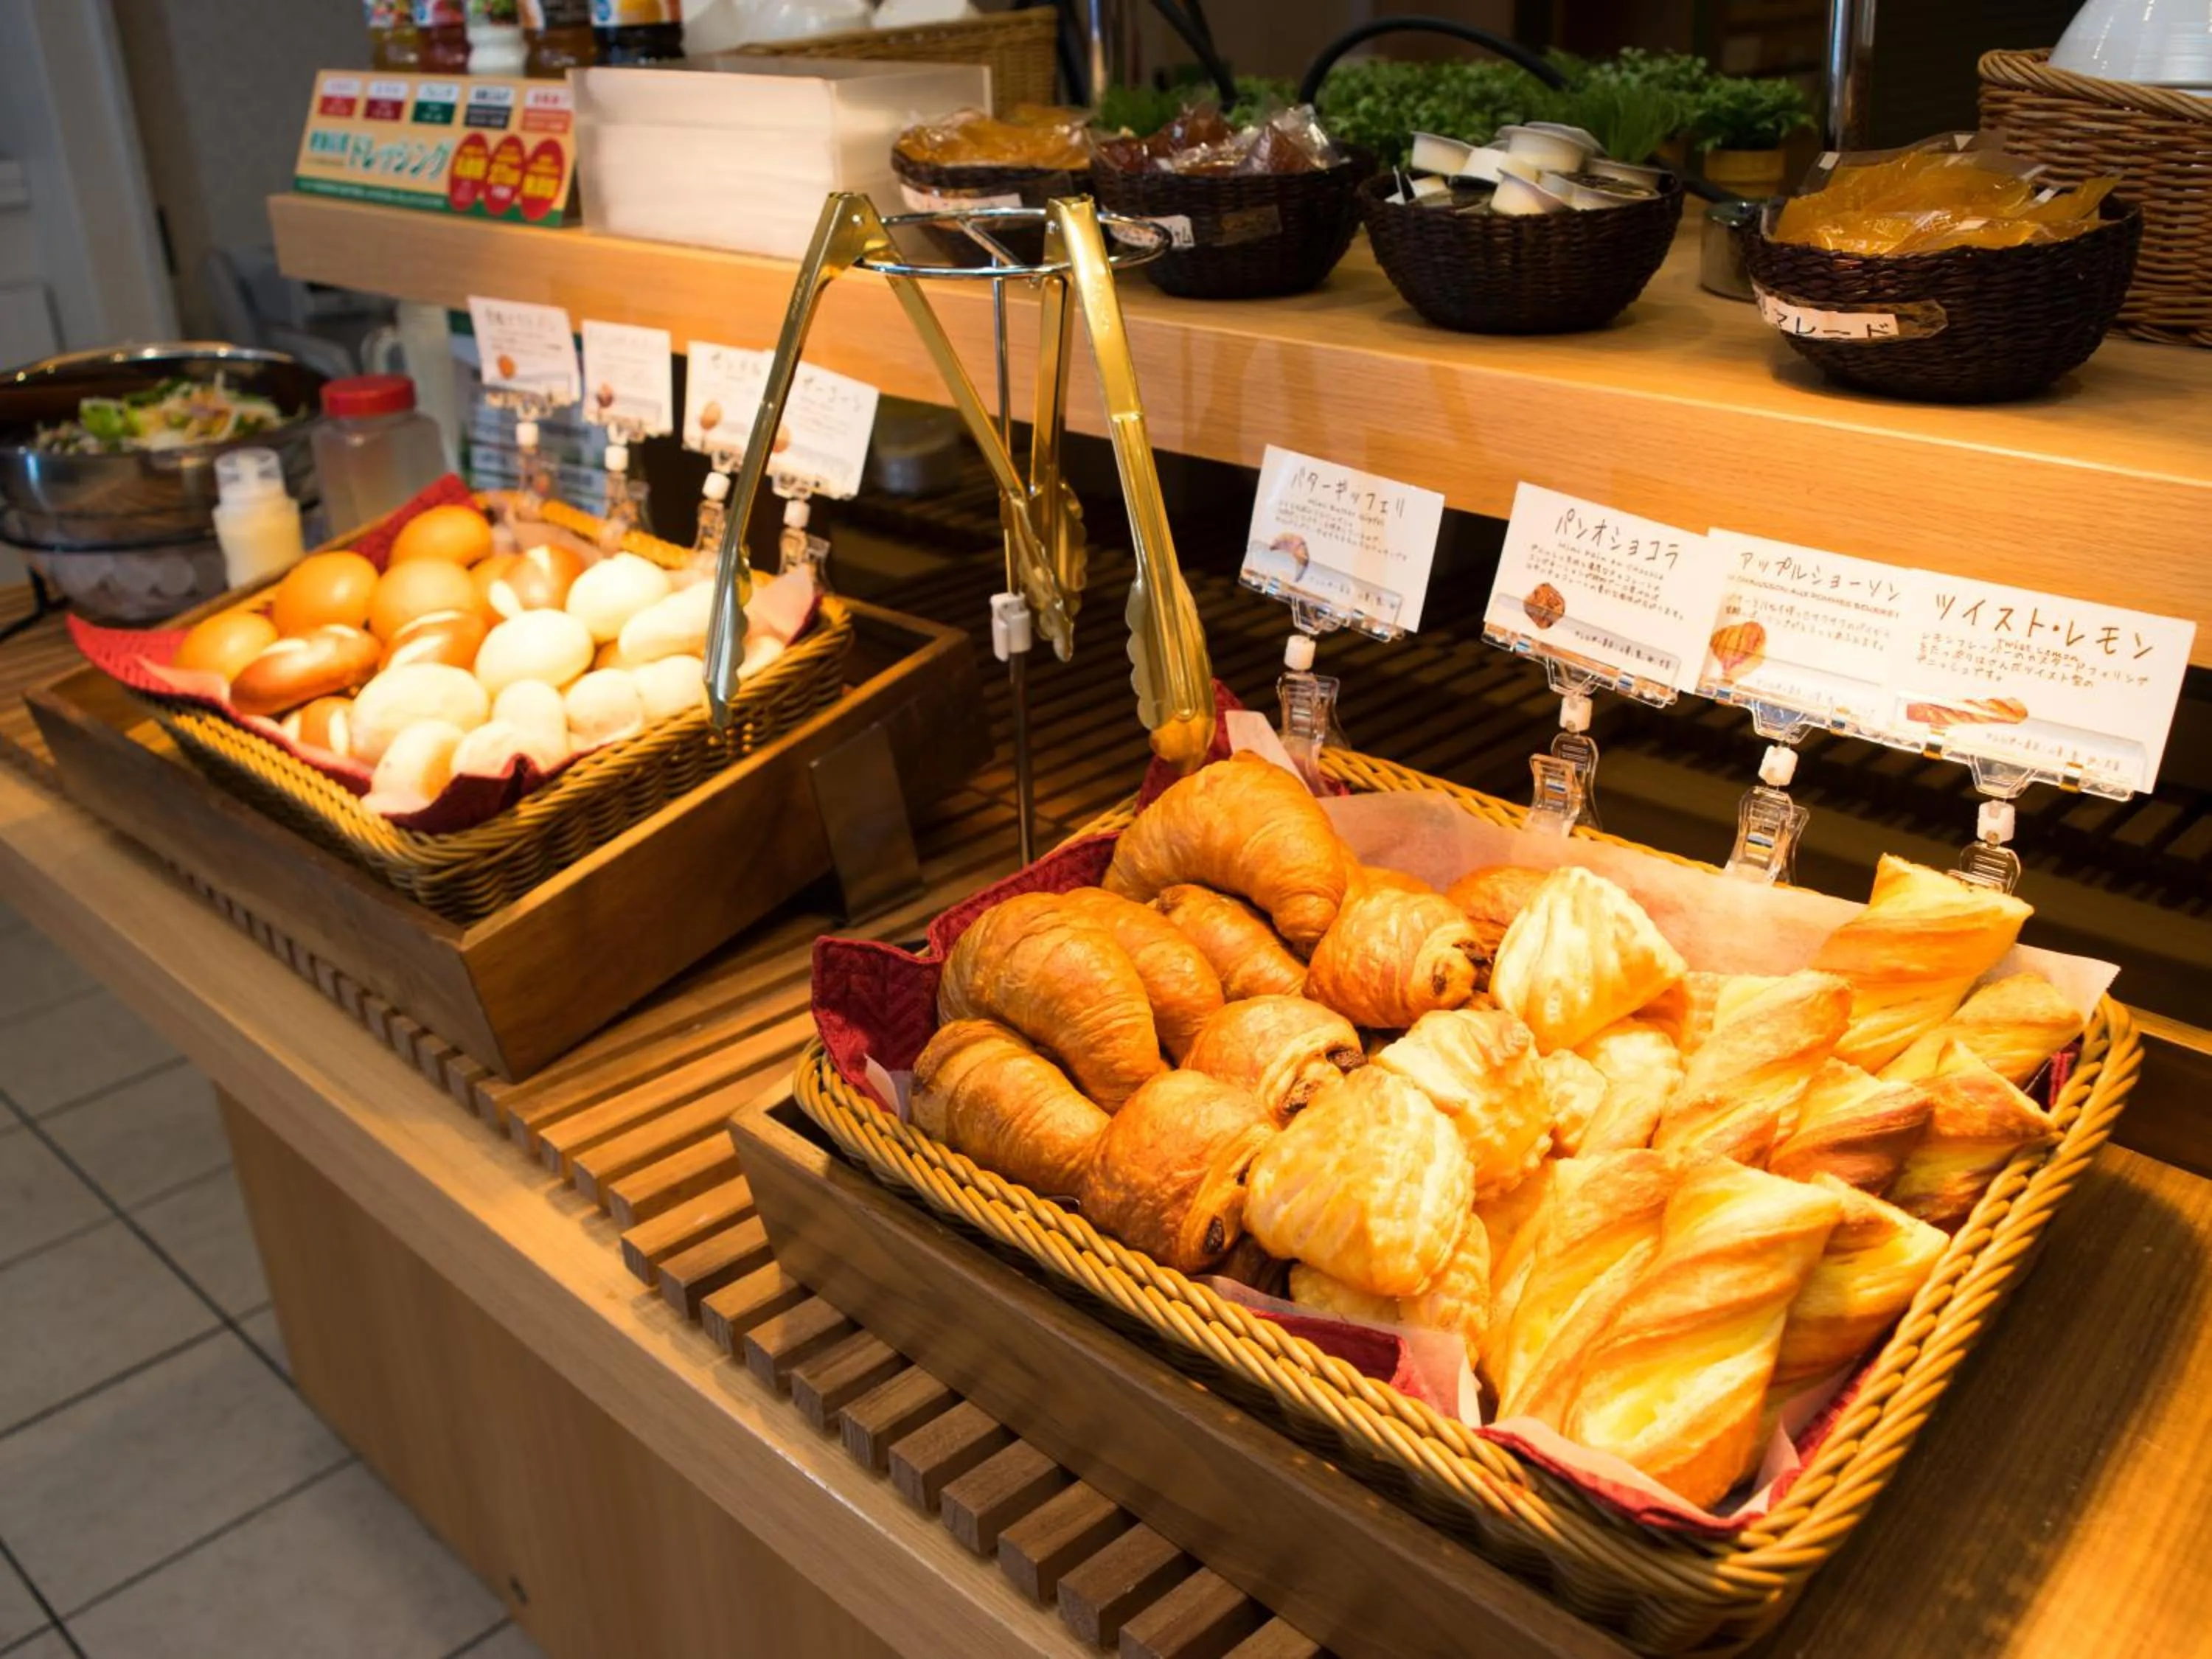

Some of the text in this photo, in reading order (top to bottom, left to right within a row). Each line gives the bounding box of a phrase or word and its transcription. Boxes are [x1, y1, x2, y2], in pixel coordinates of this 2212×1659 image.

[349, 133, 454, 182] ドレッシング
[1555, 507, 1681, 570] パンオショコラ
[1740, 551, 1902, 601] アップルショーソン
[1935, 592, 2154, 659] ツイスト・レモン
